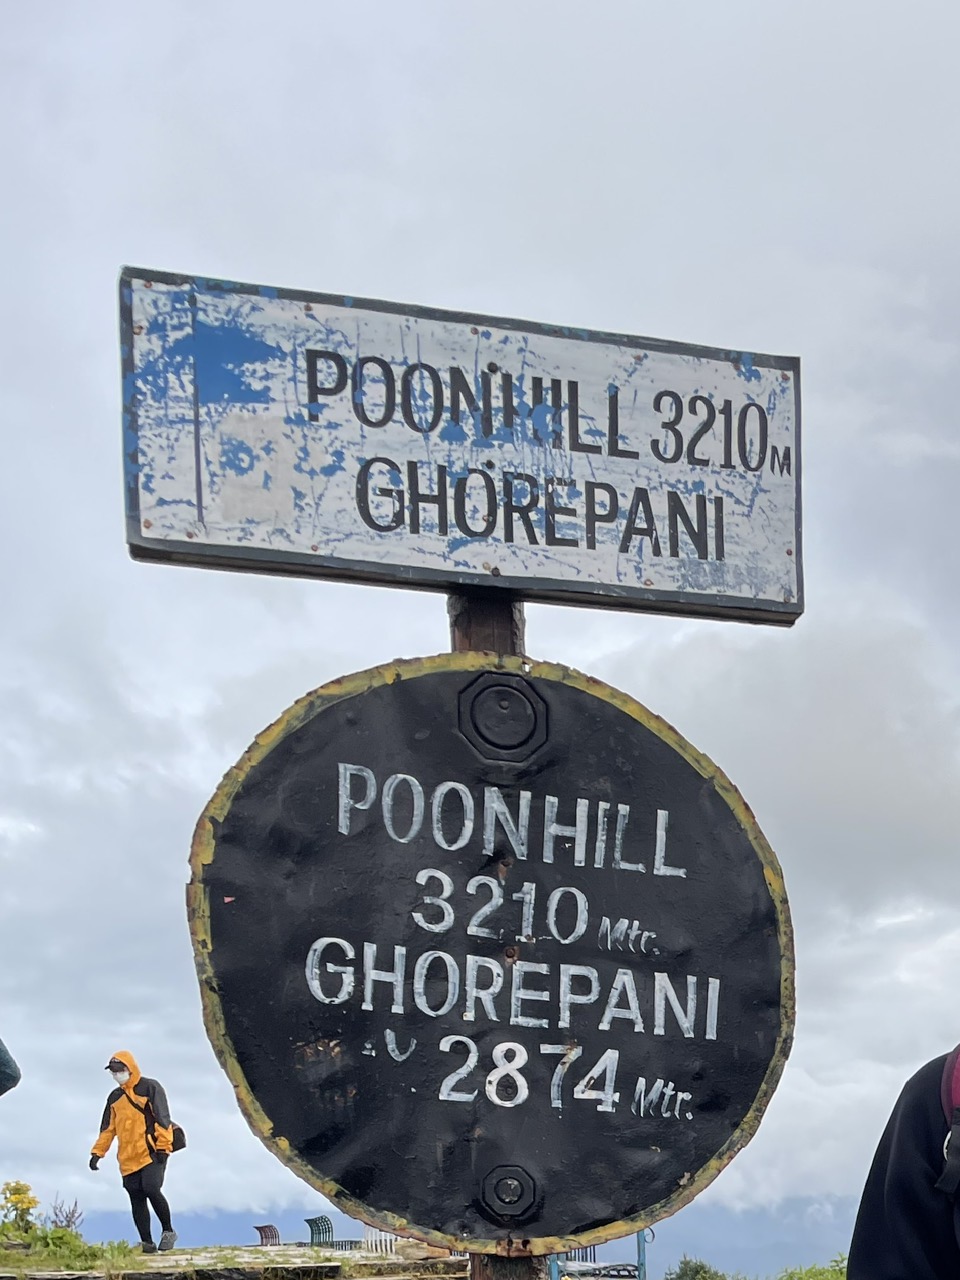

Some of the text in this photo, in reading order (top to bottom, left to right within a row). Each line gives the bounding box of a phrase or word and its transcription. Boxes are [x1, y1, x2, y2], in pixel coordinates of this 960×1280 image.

[356, 457, 724, 561] GHOREPANI
[411, 868, 589, 945] 3210
[305, 937, 720, 1040] GHOREPANI
[438, 1035, 620, 1112] 2874
